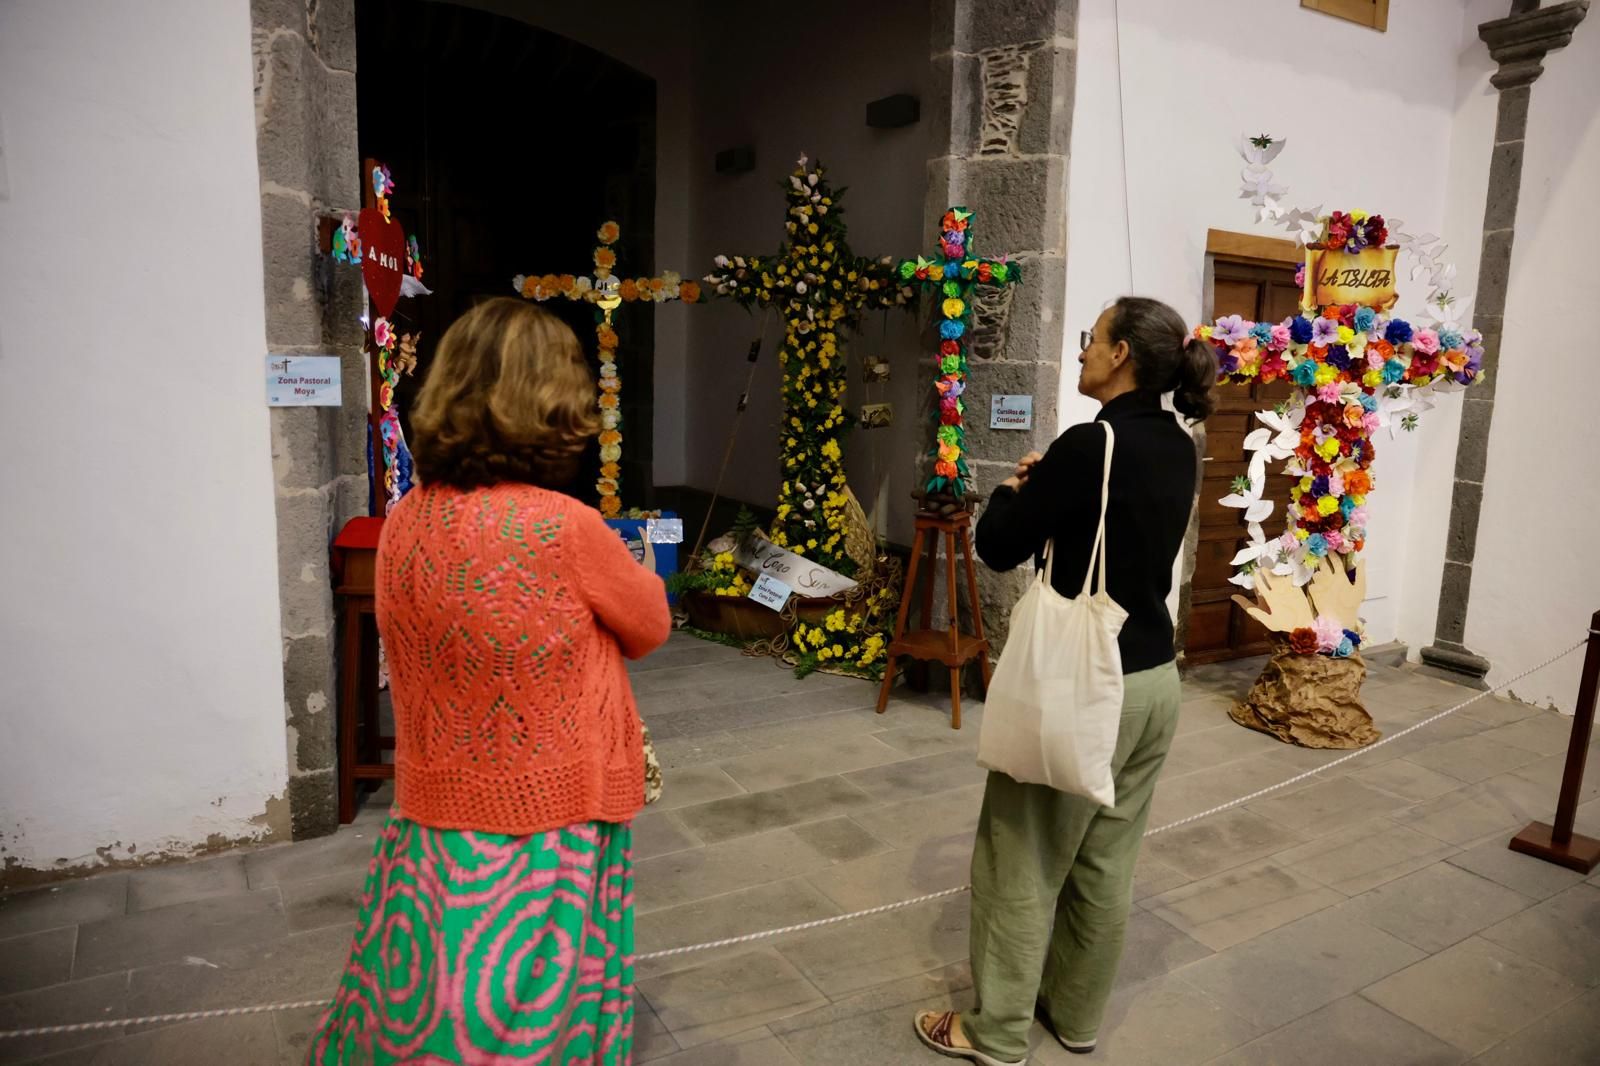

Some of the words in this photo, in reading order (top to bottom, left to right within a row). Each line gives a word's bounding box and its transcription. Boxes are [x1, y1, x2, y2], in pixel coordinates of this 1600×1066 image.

[1319, 268, 1338, 286] LA
[1338, 268, 1391, 288] ISLETA
[294, 388, 315, 397] Moya
[758, 584, 768, 592] Zona
[766, 589, 783, 599] Pastoral
